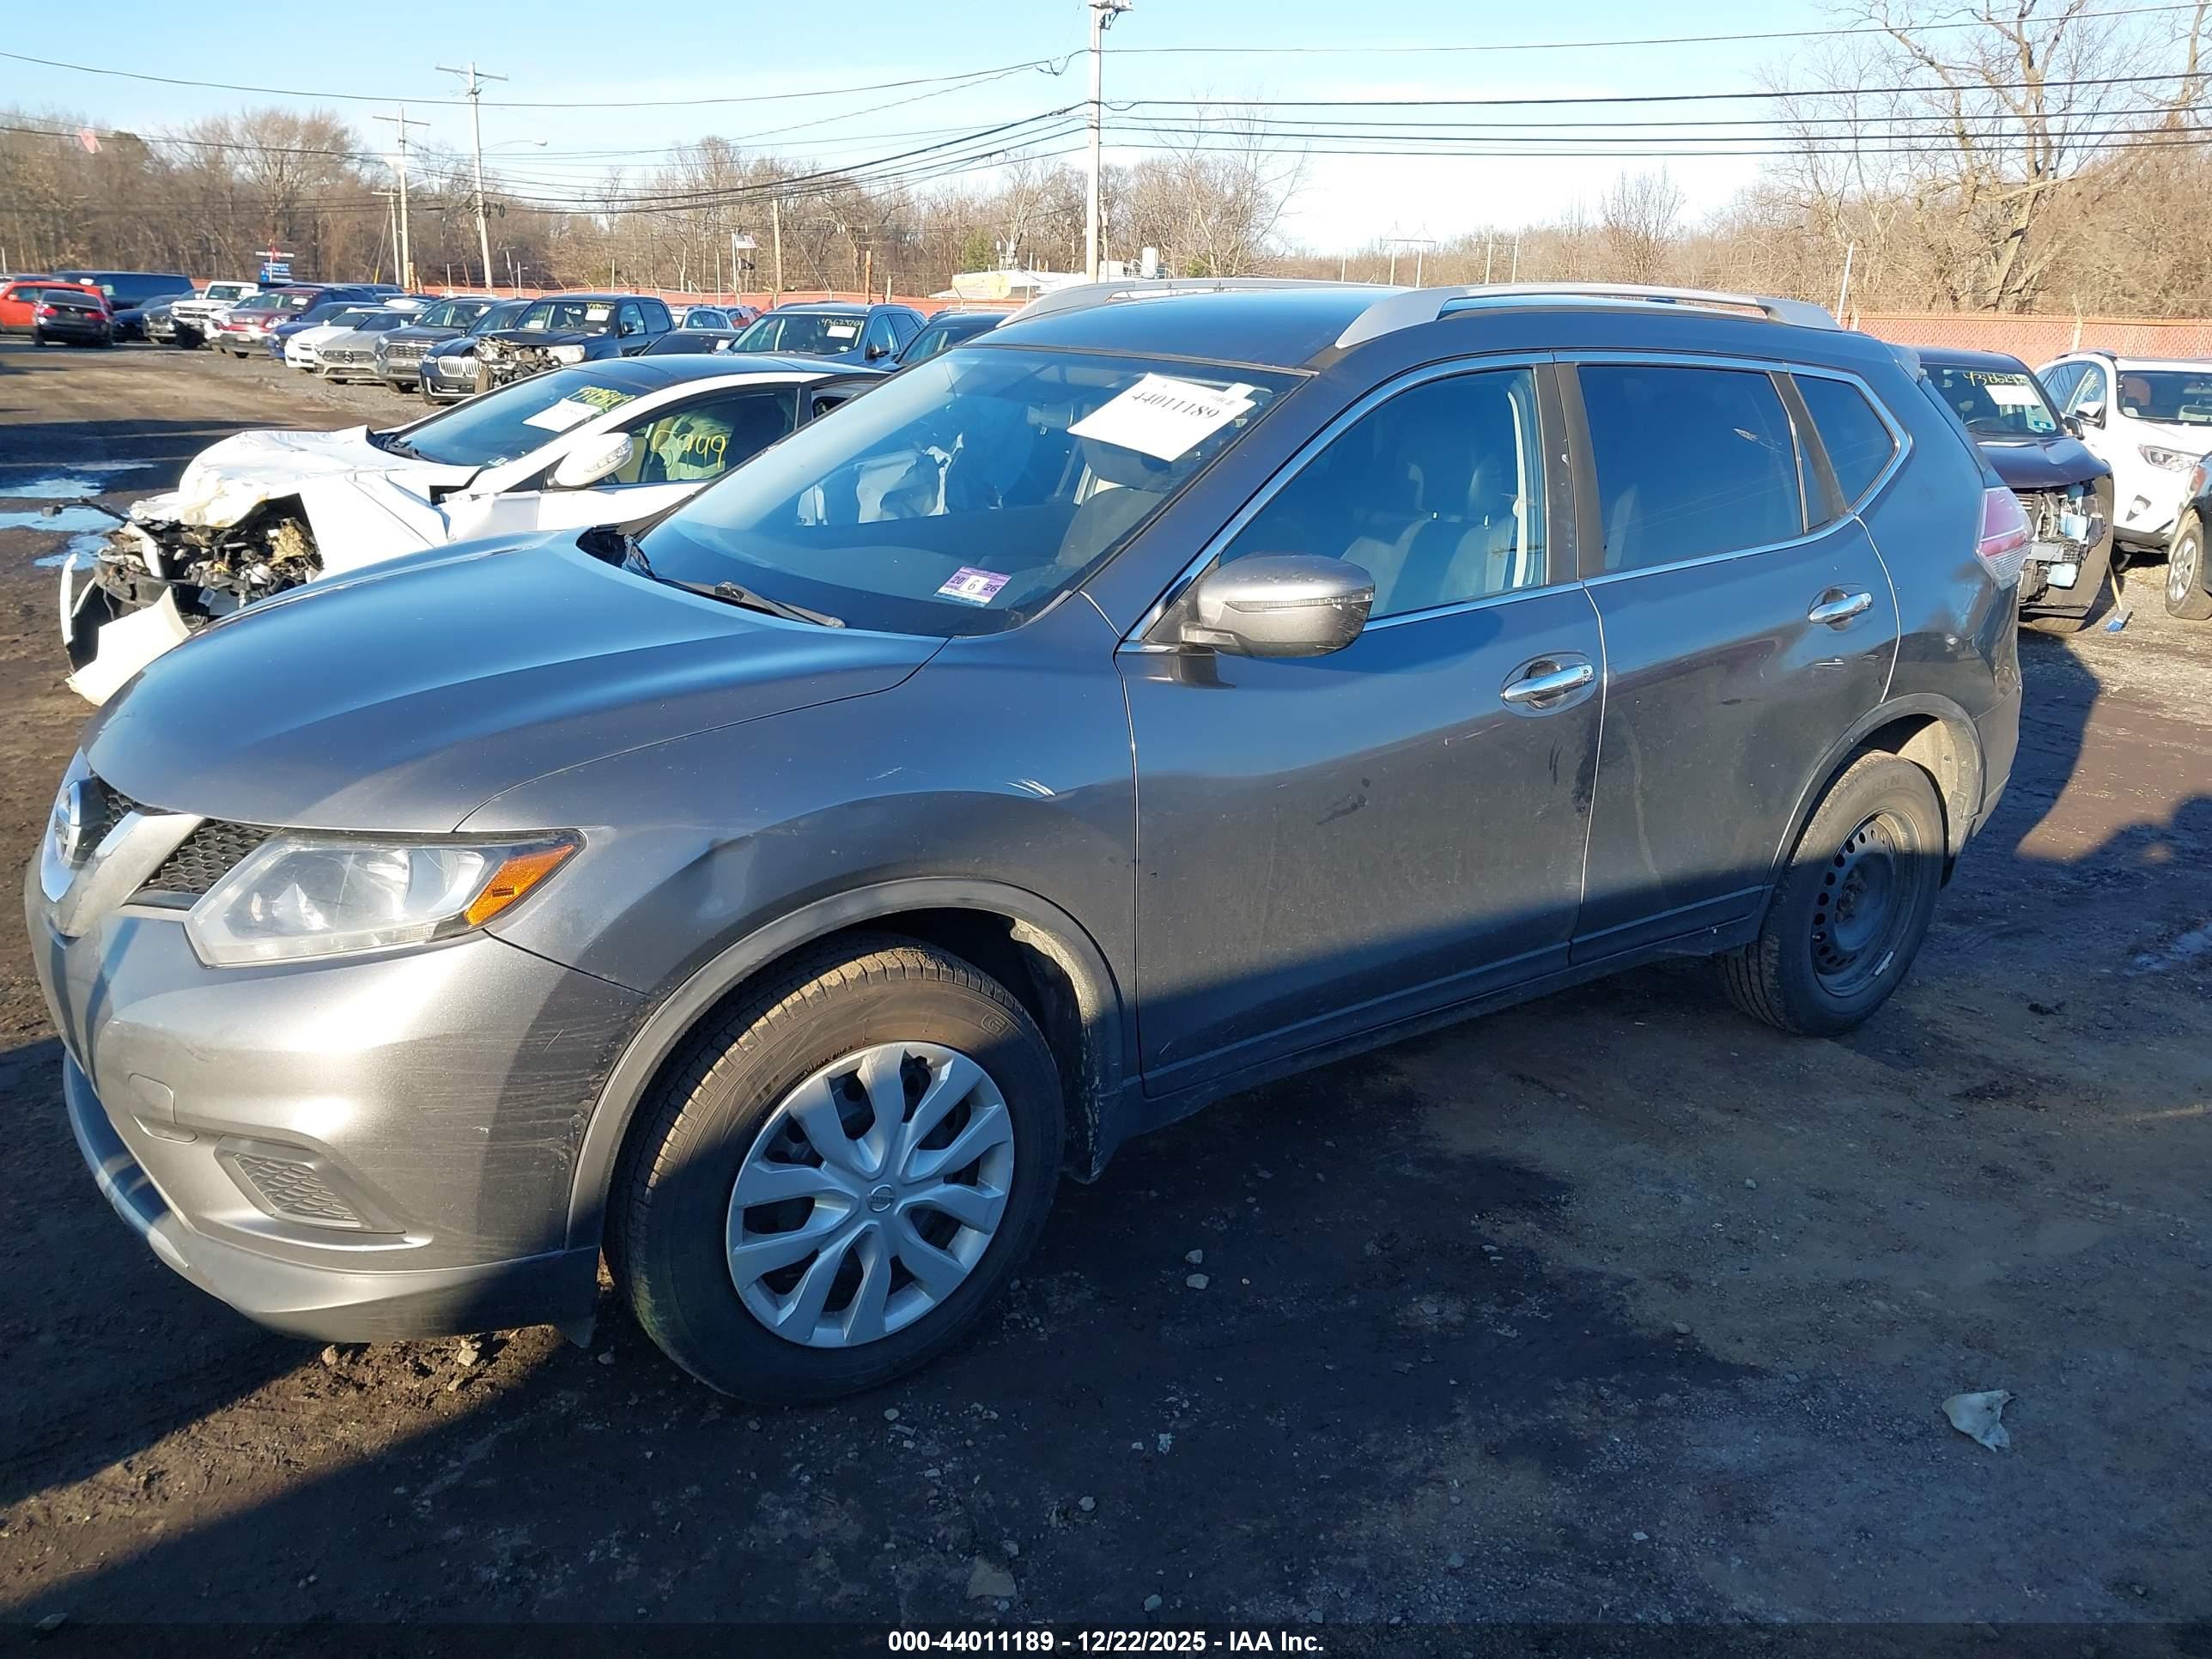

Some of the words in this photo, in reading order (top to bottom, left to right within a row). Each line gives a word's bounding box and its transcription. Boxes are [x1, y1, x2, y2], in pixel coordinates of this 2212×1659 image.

[1132, 392, 1220, 419] 44011189
[951, 575, 966, 585] 20
[968, 579, 981, 591] 6
[983, 584, 1000, 592] 26
